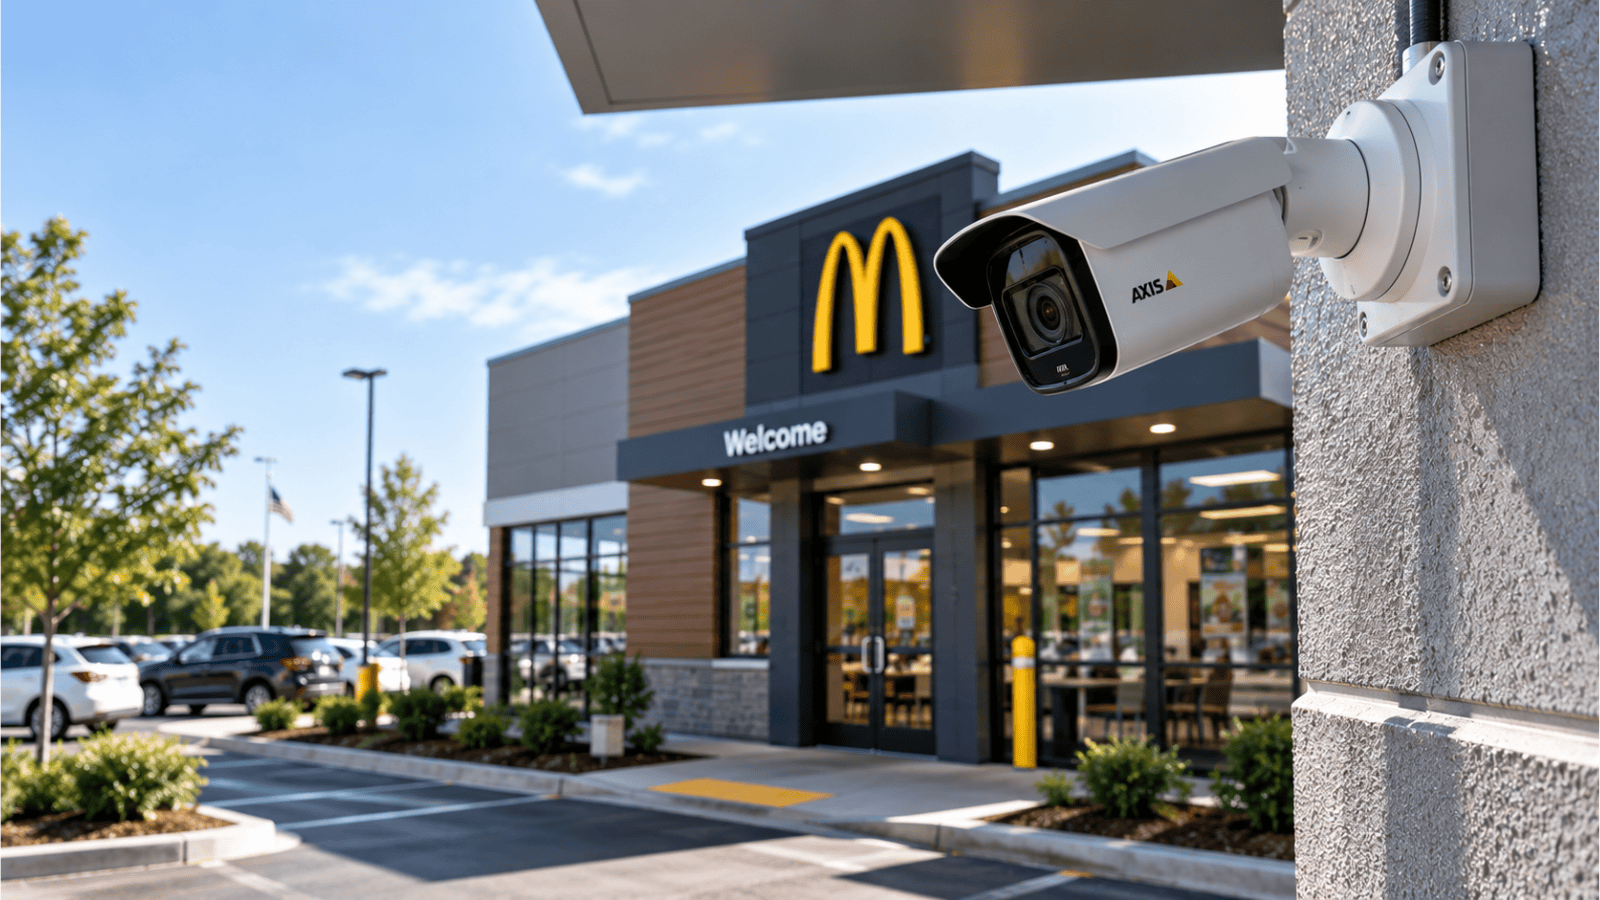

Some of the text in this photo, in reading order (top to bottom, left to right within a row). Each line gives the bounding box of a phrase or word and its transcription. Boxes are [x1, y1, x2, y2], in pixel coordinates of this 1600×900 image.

[812, 216, 924, 373] M
[1132, 278, 1164, 304] AXIS
[723, 420, 828, 457] Welcome
